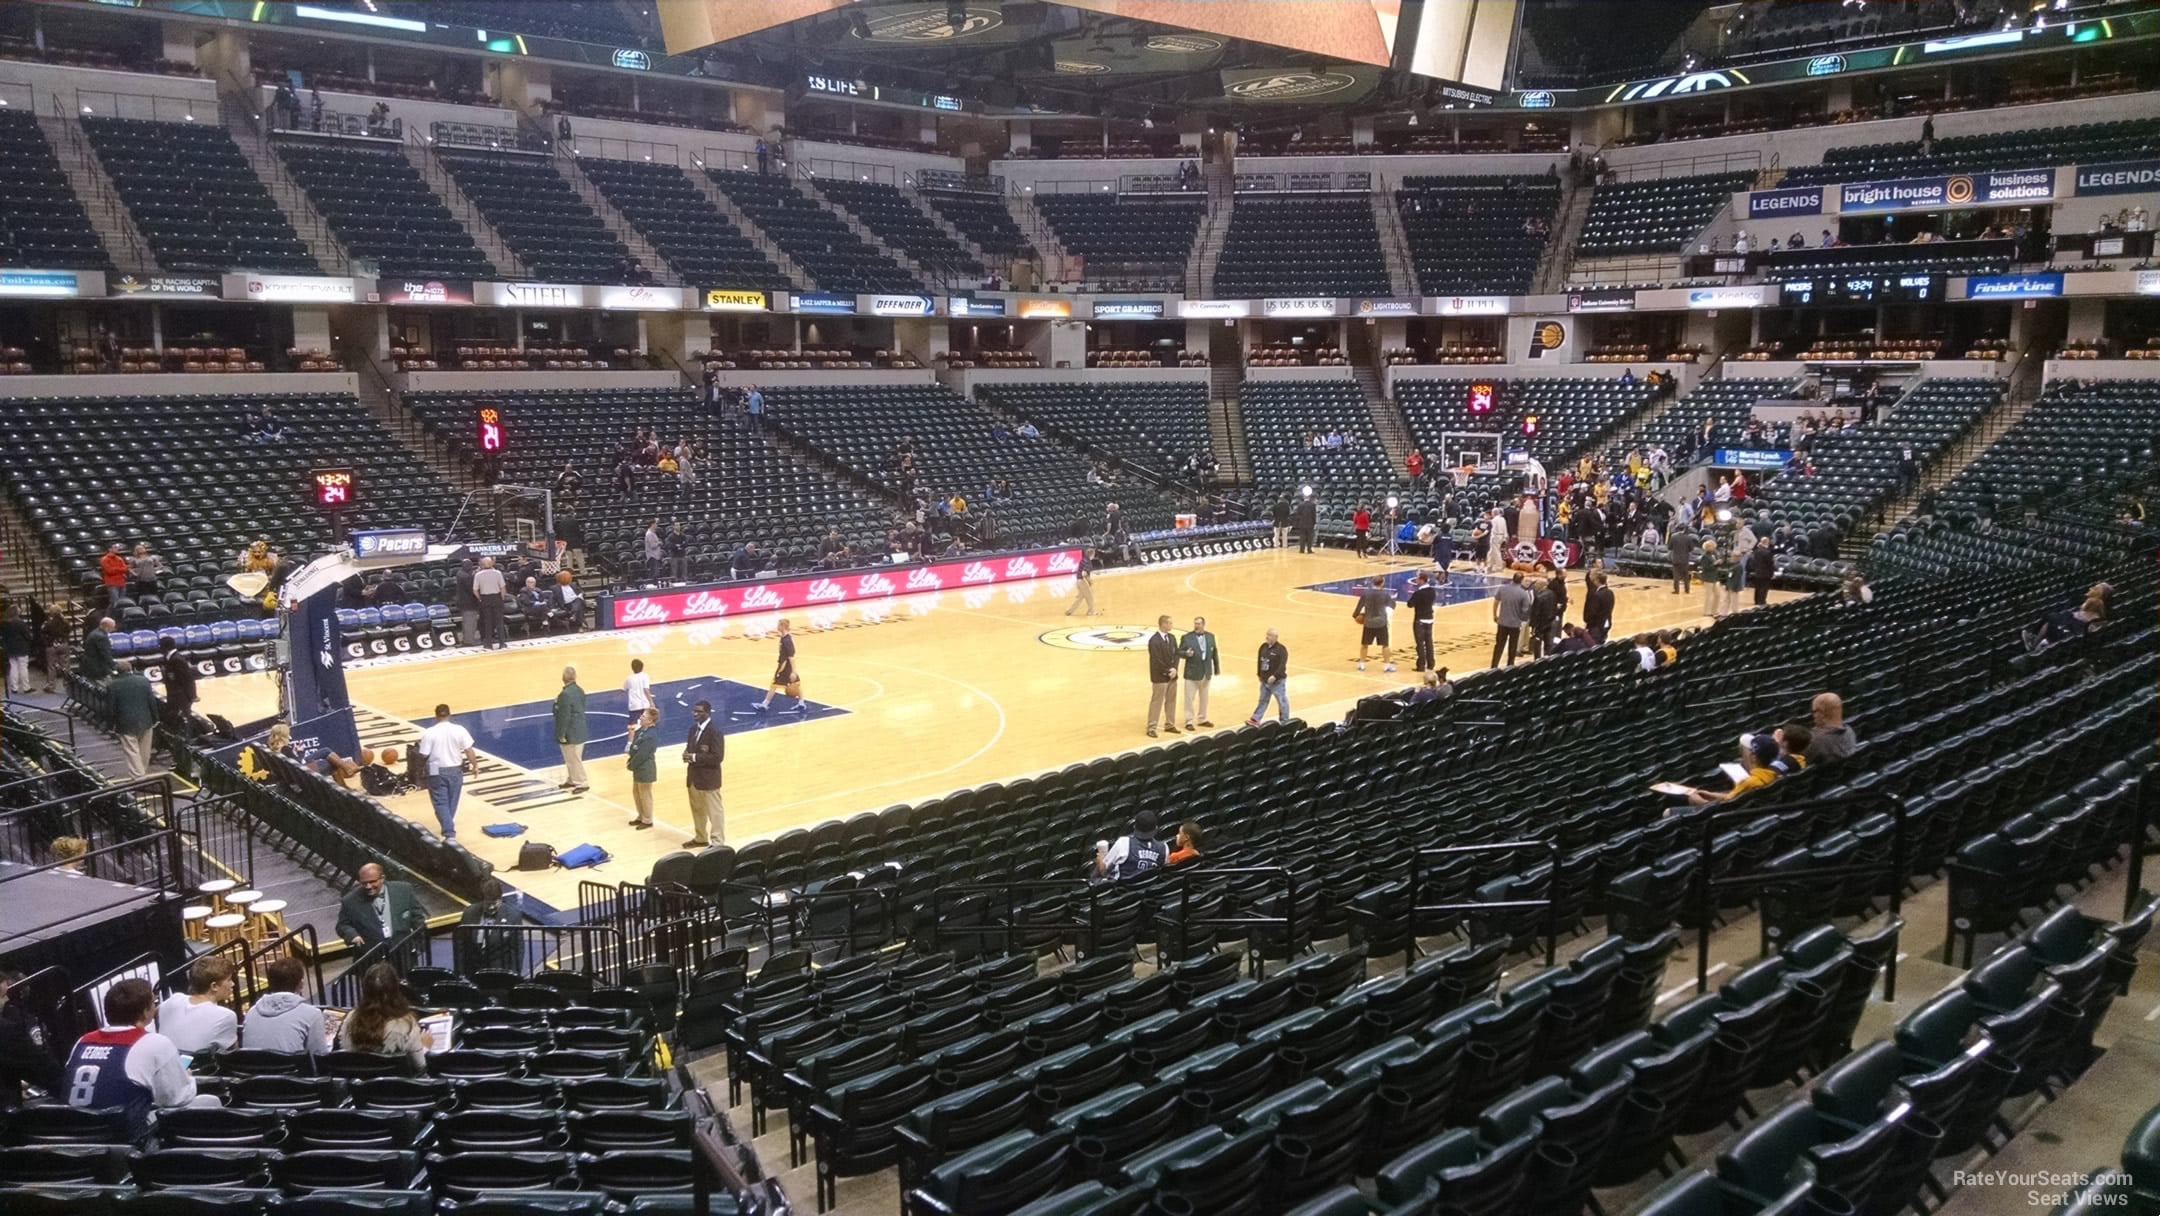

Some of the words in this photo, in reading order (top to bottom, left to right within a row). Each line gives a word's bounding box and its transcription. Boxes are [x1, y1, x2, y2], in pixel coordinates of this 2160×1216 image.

[828, 80, 858, 95] LIFE
[1442, 87, 1470, 100] MITSUBISHI
[1470, 93, 1493, 104] ELECTRIC
[1990, 174, 2048, 186] business
[1844, 188, 1891, 204] bright
[1893, 186, 1942, 200] house
[1989, 185, 2049, 199] solutions
[1752, 194, 1819, 212] LEGENDS
[404, 283, 424, 292] the
[1900, 277, 1930, 287] WOLVES
[1974, 281, 2018, 294] Finish
[2021, 280, 2055, 292] Line
[712, 295, 761, 305] STANLEY
[1717, 291, 1761, 300] Kinetico
[1802, 292, 1810, 303] 0
[1919, 288, 1927, 298] 0
[876, 300, 922, 309] DEFENDER
[1094, 305, 1120, 313] SPORT
[1121, 305, 1162, 313] GRAPHICS
[1472, 394, 1491, 411] 24
[483, 423, 499, 449] 24
[316, 474, 350, 485] 43:24
[325, 487, 345, 502] 24
[378, 538, 424, 552] Pacers
[621, 598, 670, 622] Lilly
[683, 592, 728, 616] Lilly
[741, 585, 784, 609] Lilly
[806, 578, 847, 601] Lilly
[857, 573, 896, 595] Lilly
[906, 567, 943, 589] Lilly
[961, 561, 997, 582] Lilly
[1006, 556, 1038, 577] Lilly
[1048, 552, 1079, 572] Lilly
[81, 1046, 114, 1060] GEORGE
[68, 1065, 101, 1106] 8
